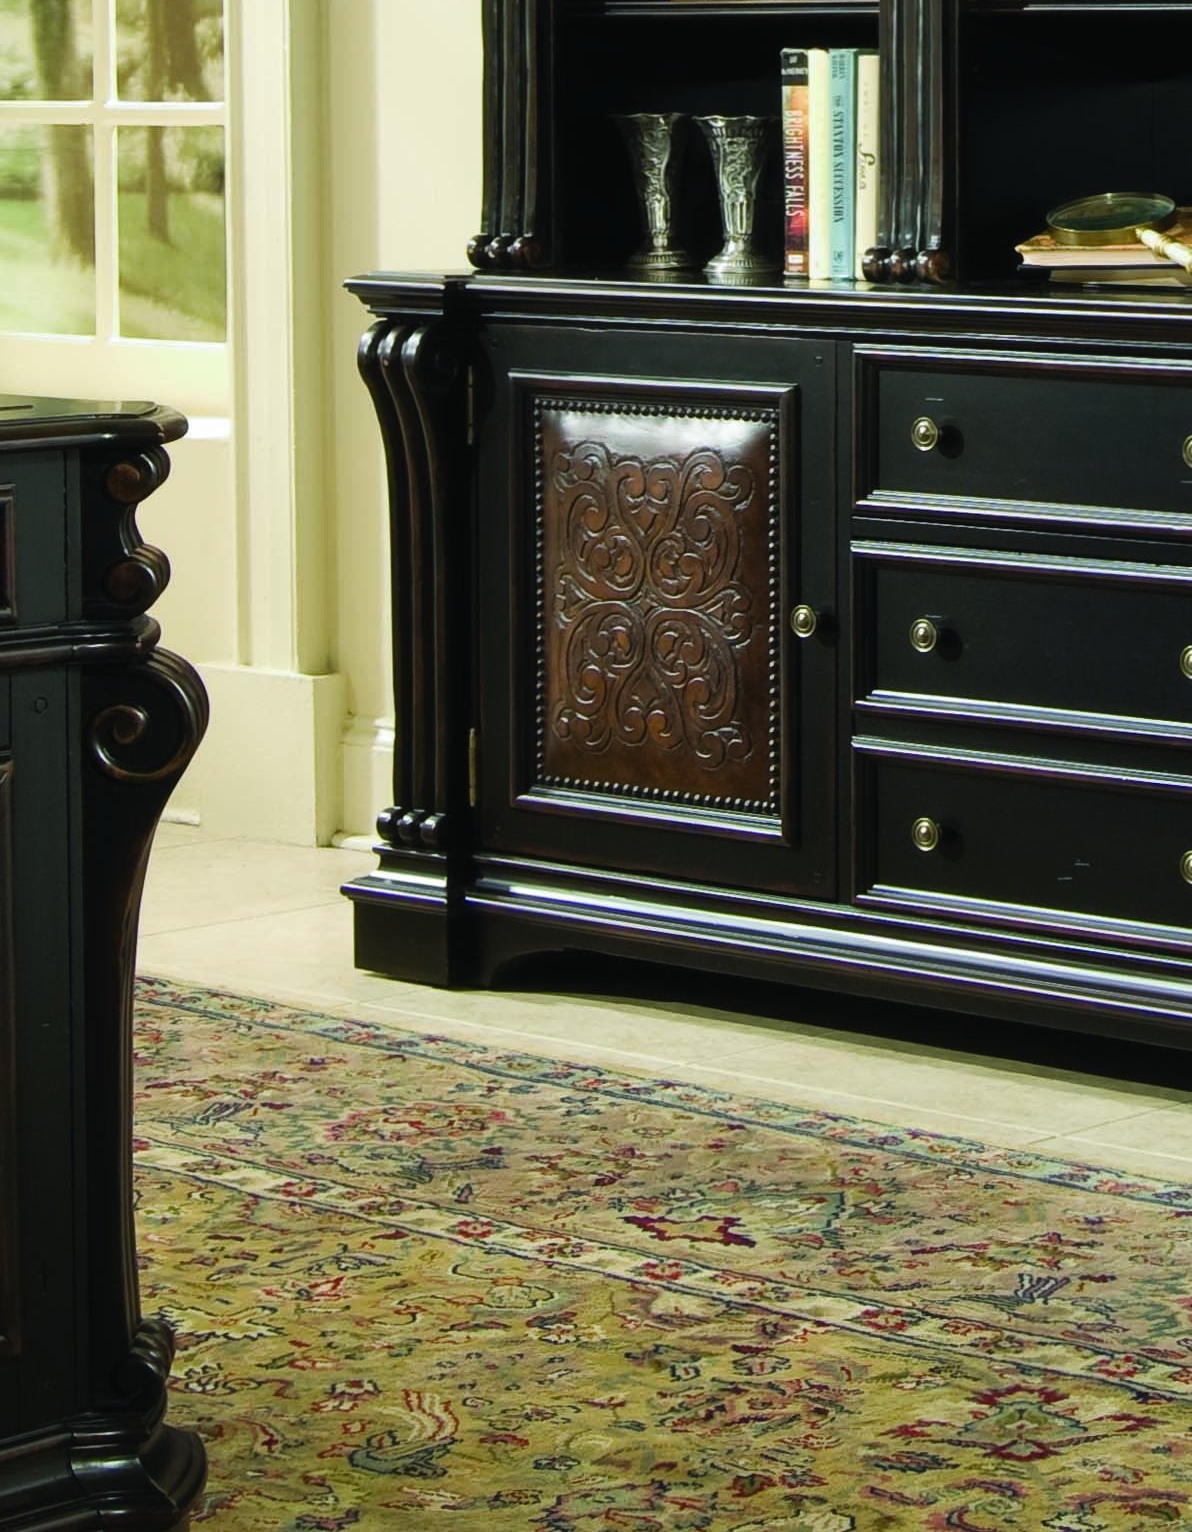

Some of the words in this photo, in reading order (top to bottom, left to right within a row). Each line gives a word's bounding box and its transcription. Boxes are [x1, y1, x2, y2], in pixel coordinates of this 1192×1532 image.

[785, 110, 805, 179] BRIGHTNESS
[833, 111, 844, 157] STANTON
[785, 185, 806, 217] FALLS
[833, 162, 844, 223] SUCCESSION
